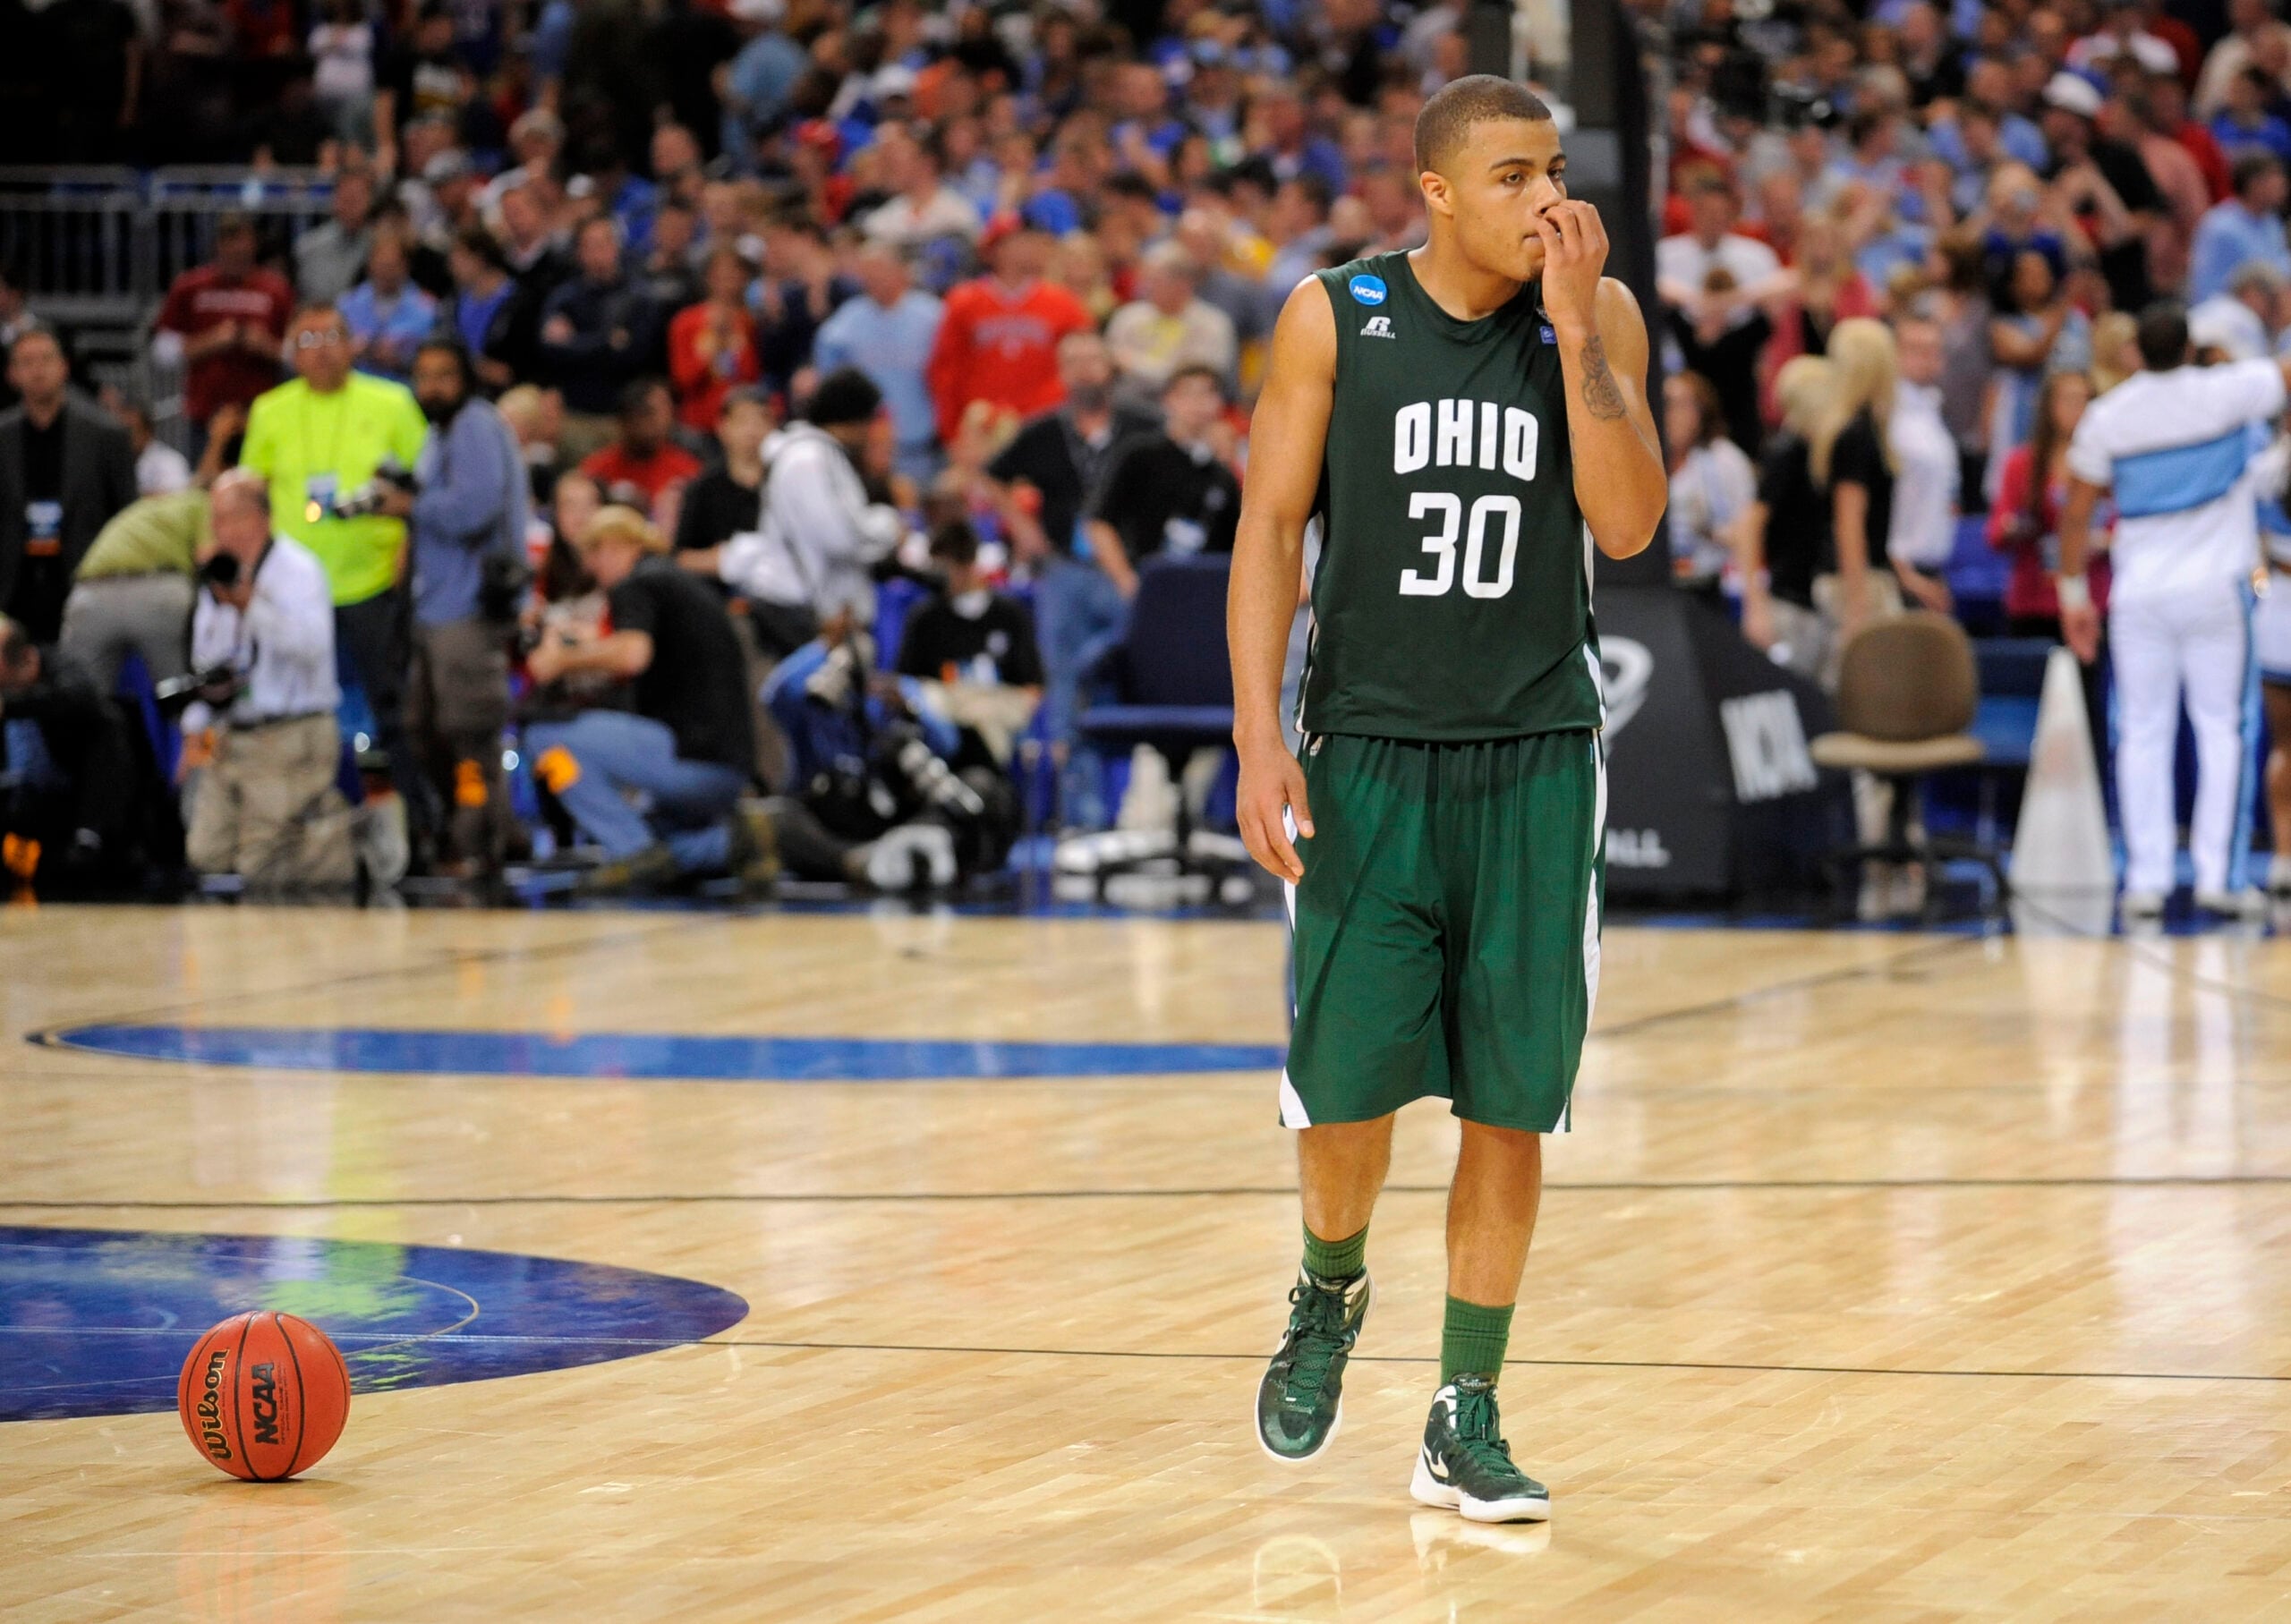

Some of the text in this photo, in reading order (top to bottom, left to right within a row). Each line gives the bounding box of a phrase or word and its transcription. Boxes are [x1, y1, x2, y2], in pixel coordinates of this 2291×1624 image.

[1353, 285, 1384, 300] NCAA
[1360, 327, 1396, 339] RUSSELL
[1394, 399, 1539, 481] OHIO
[1399, 492, 1522, 599] 30
[197, 1348, 233, 1460] Wilson
[251, 1362, 279, 1445] NCAA
